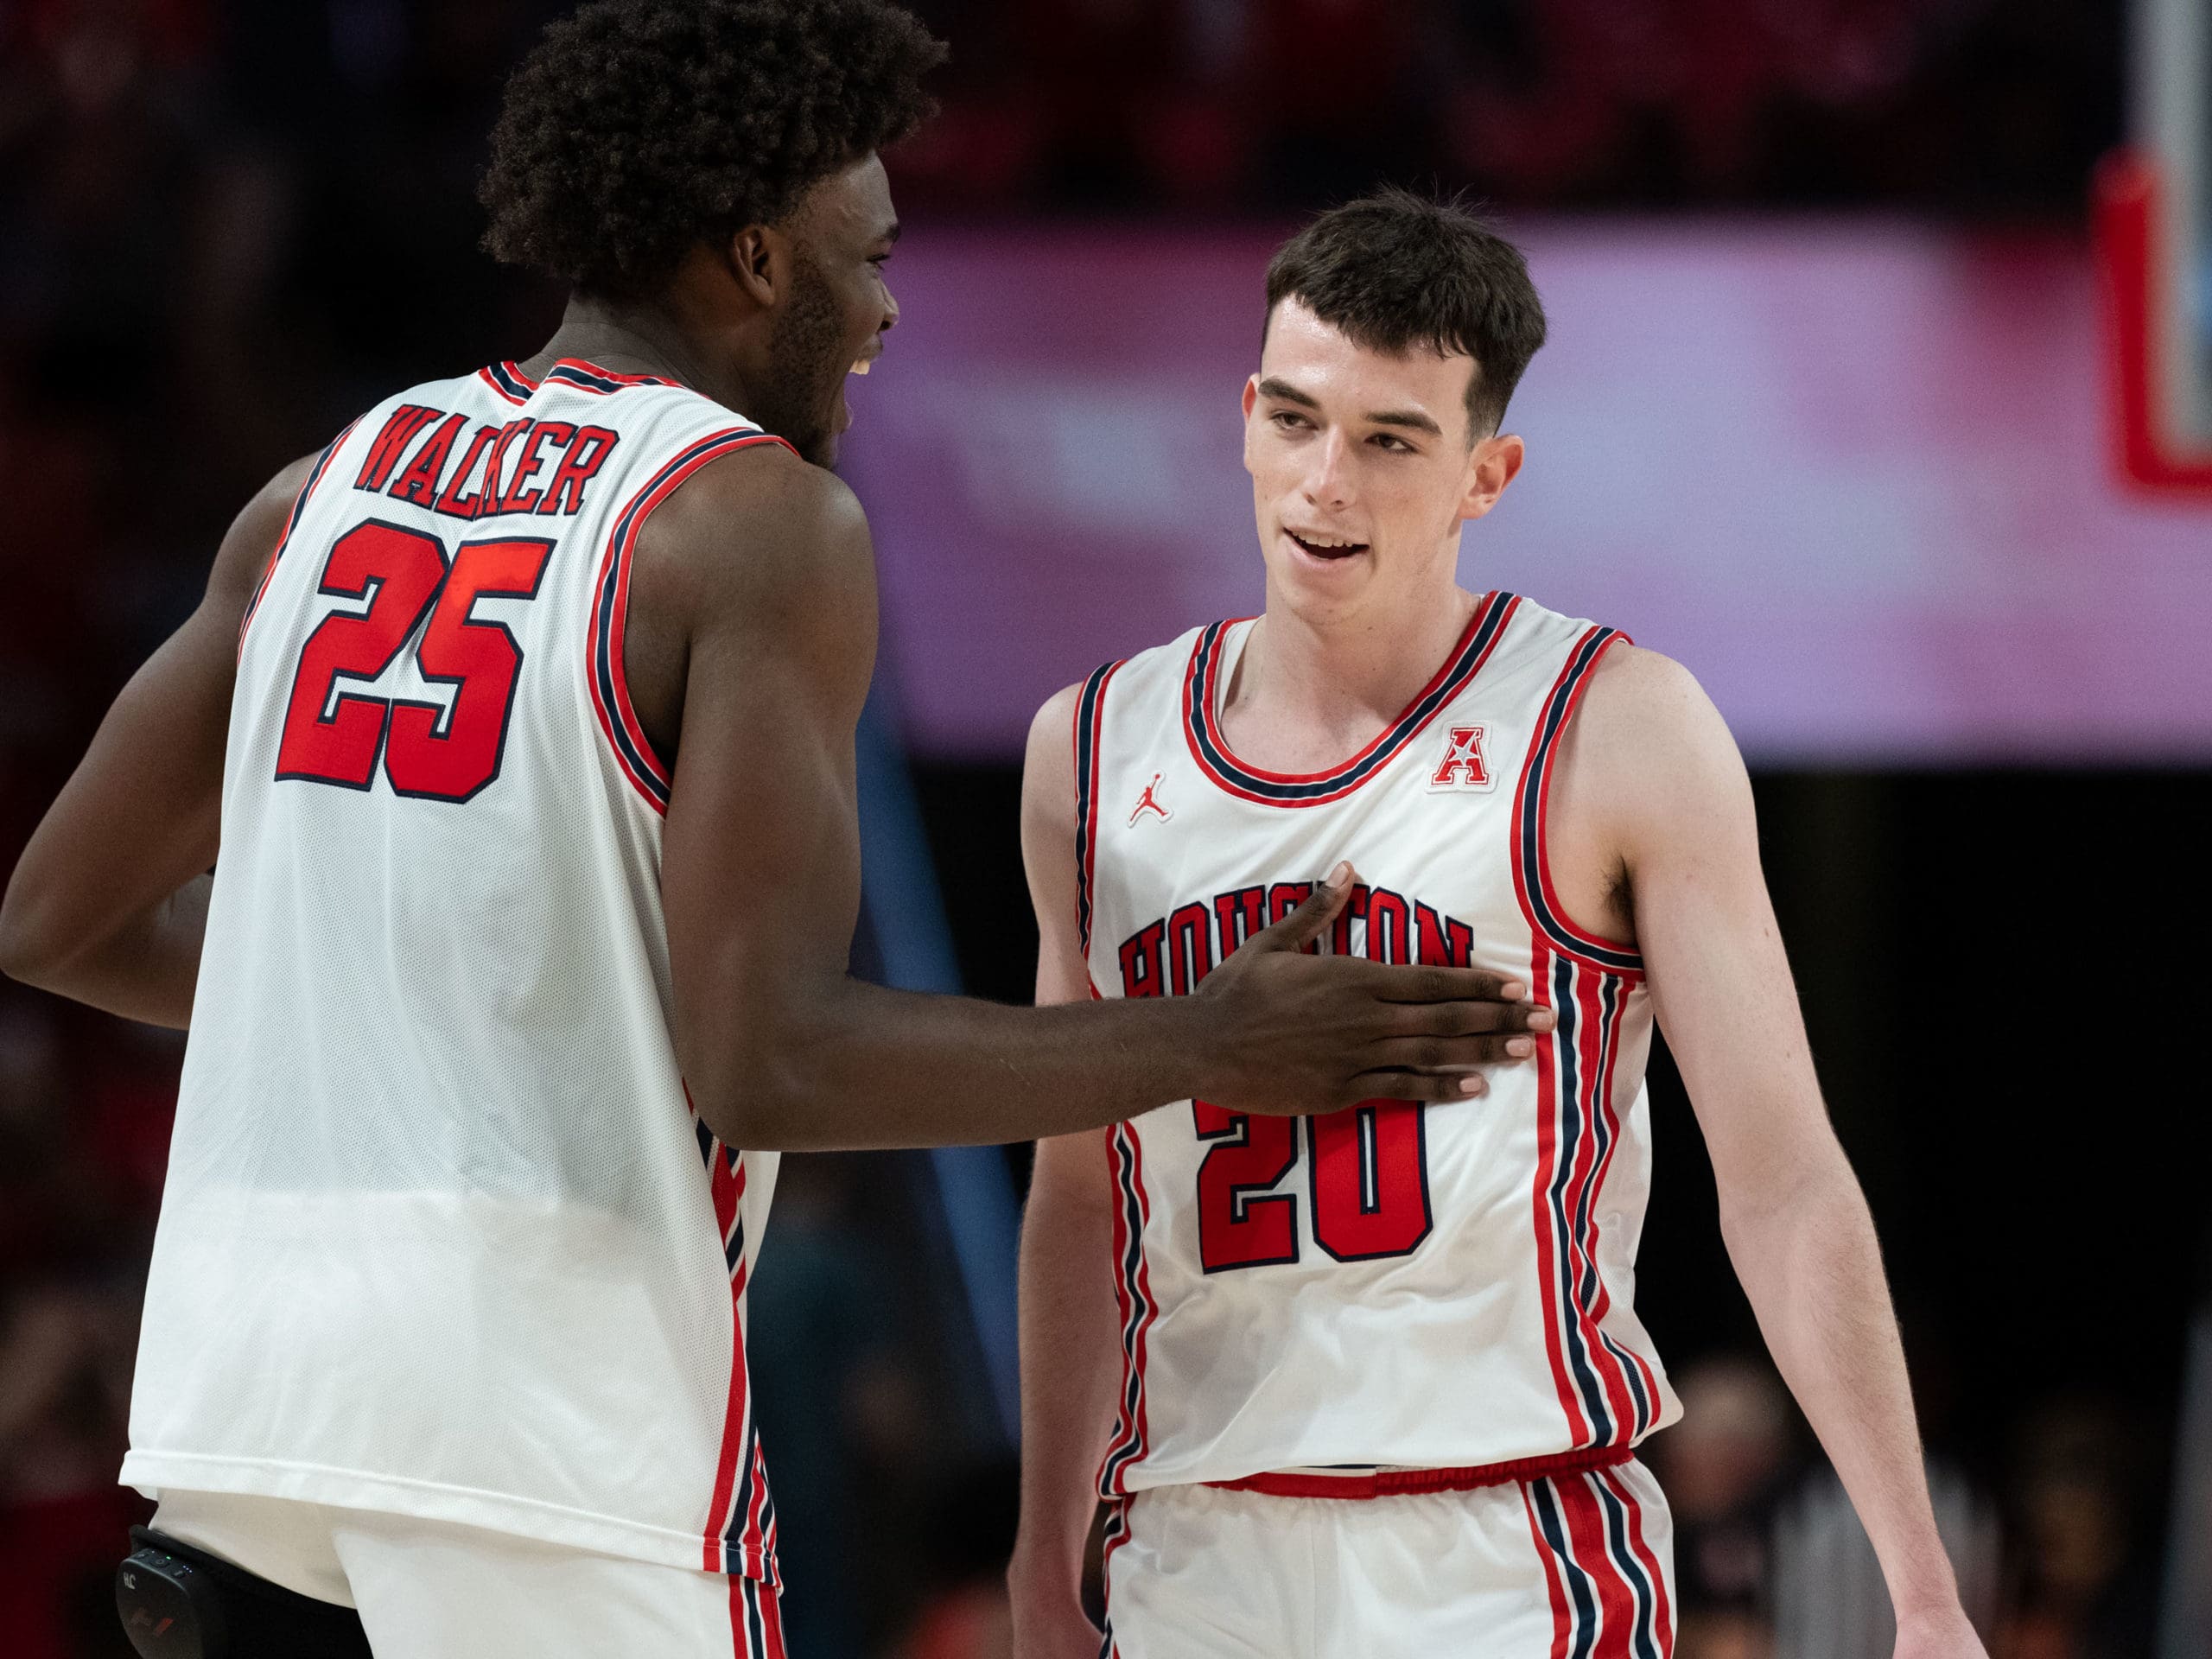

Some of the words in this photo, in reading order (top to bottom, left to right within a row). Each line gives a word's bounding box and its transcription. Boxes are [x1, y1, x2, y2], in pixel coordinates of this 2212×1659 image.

[353, 404, 620, 521] WALKER
[274, 517, 557, 804] 25
[1431, 727, 1490, 785] A
[1192, 1098, 1433, 1274] 20
